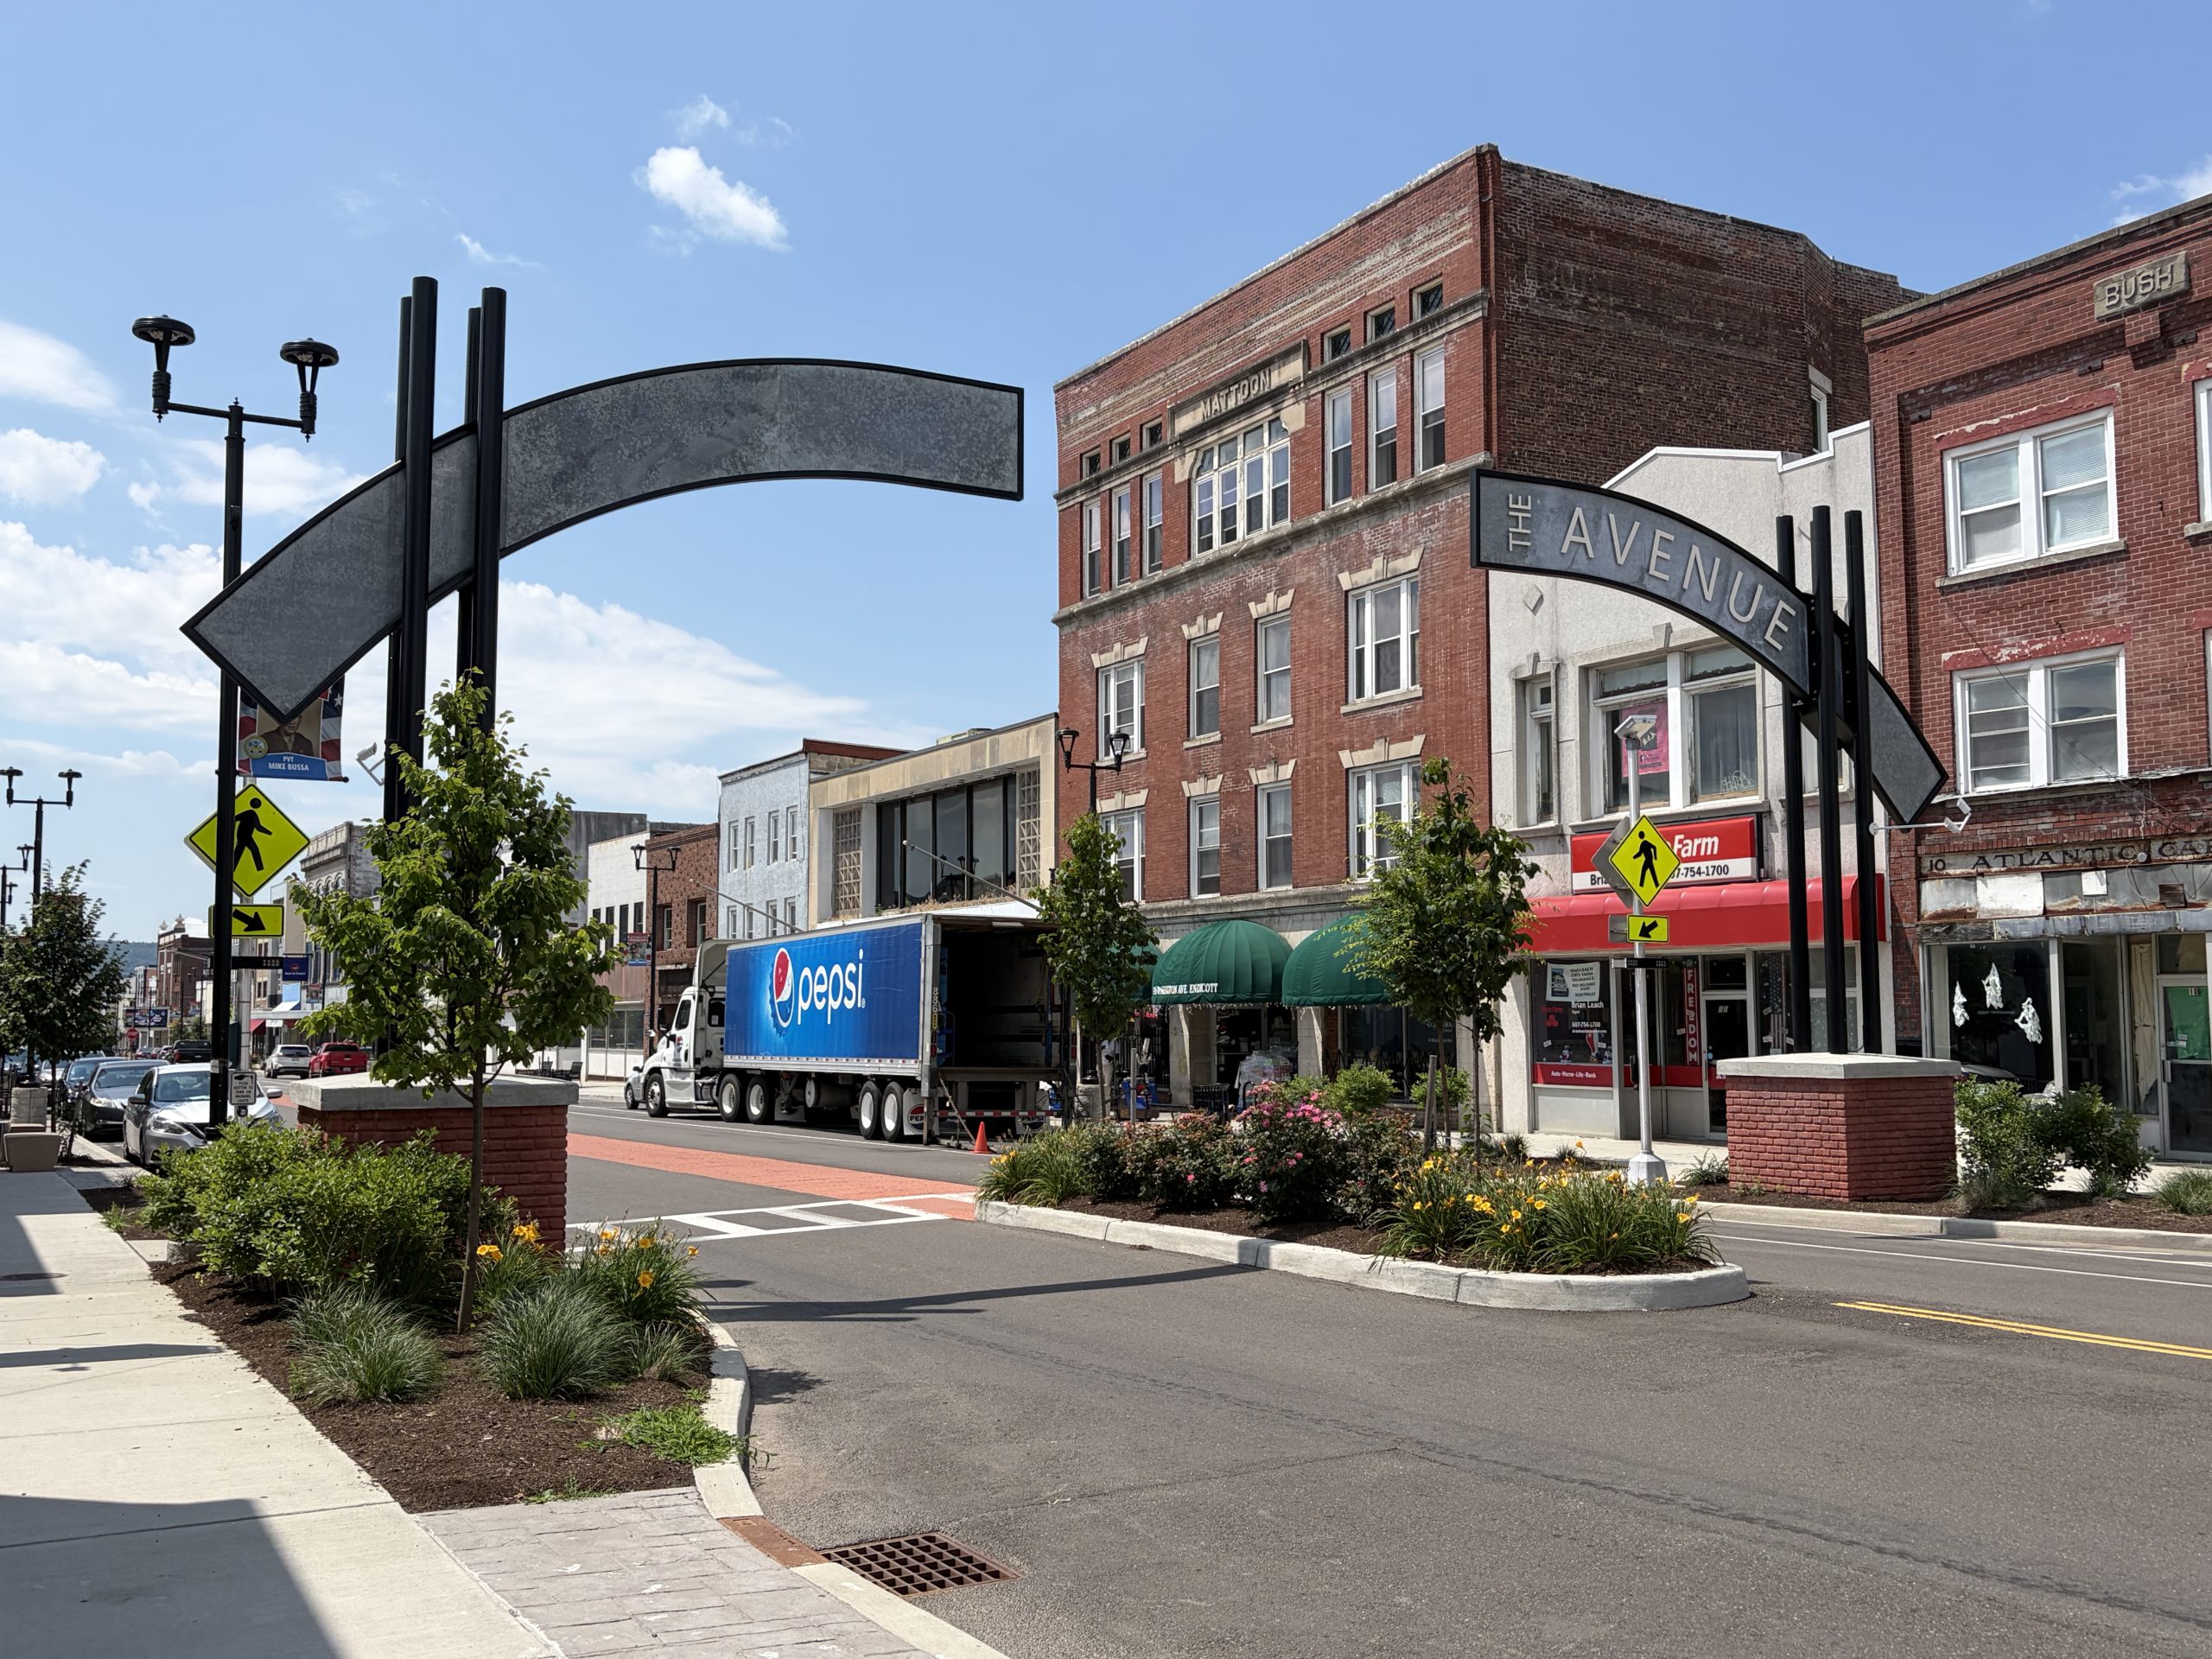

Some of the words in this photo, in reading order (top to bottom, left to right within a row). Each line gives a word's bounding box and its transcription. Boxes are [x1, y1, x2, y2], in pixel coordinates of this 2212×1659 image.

[2105, 263, 2174, 308] BUSH
[1201, 368, 1272, 421] MATTOON
[1509, 493, 1531, 551] THE
[1560, 506, 1796, 651] AVENUE
[1673, 834, 1719, 858] Farm
[1929, 859, 1946, 871] 10
[1971, 845, 2138, 868] ATLANTIC
[1590, 874, 1609, 886] Bri
[1670, 864, 1730, 879] 7-754-1700
[797, 948, 864, 1026] pepsi
[1189, 982, 1218, 994] ENDICOTT
